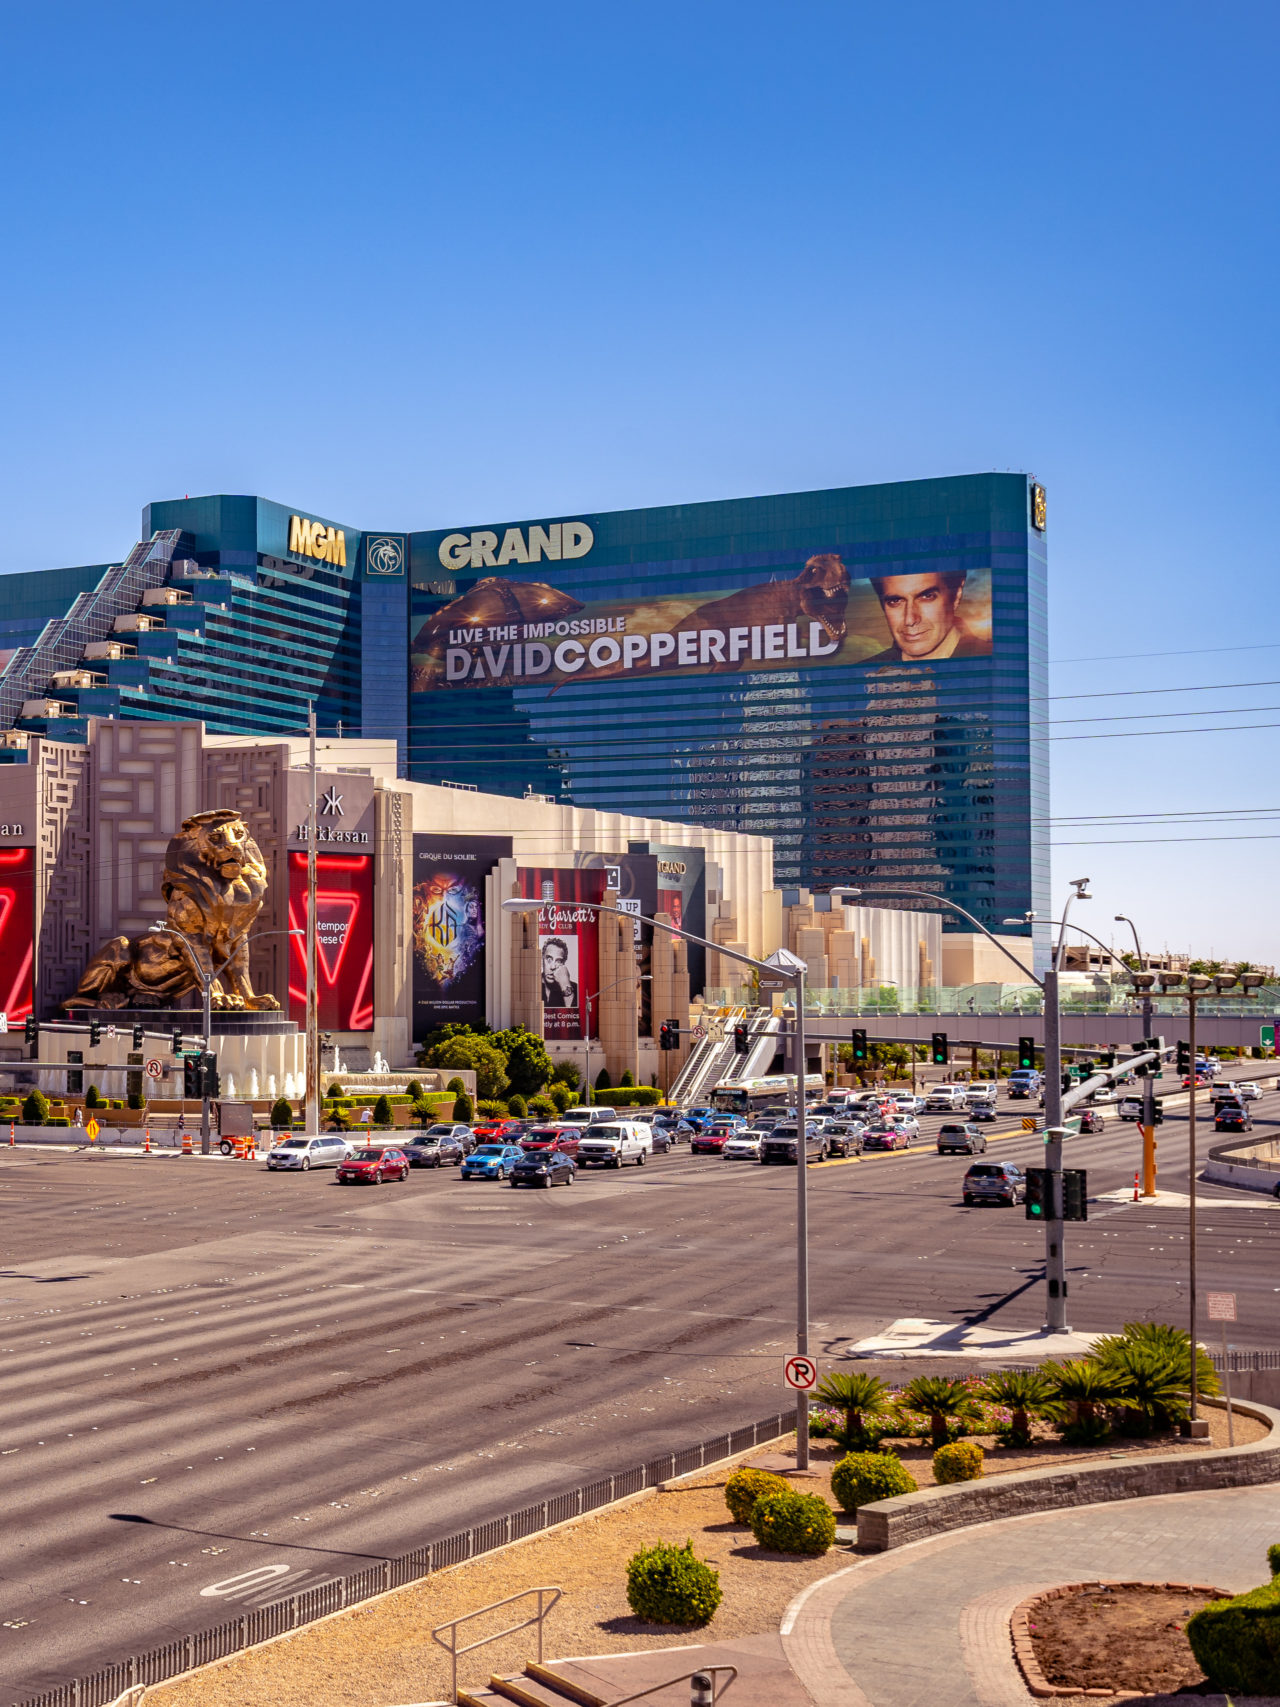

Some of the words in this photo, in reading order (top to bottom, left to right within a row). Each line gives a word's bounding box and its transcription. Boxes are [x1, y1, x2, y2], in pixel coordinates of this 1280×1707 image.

[289, 514, 347, 567] MGM
[438, 521, 595, 571] GRAND
[449, 628, 483, 645] LIVE
[487, 625, 518, 641] THE
[523, 616, 626, 639] IMPOSSIBLE
[298, 825, 369, 843] Hkkasan
[548, 905, 596, 930] Garrett's
[626, 902, 638, 911] UP
